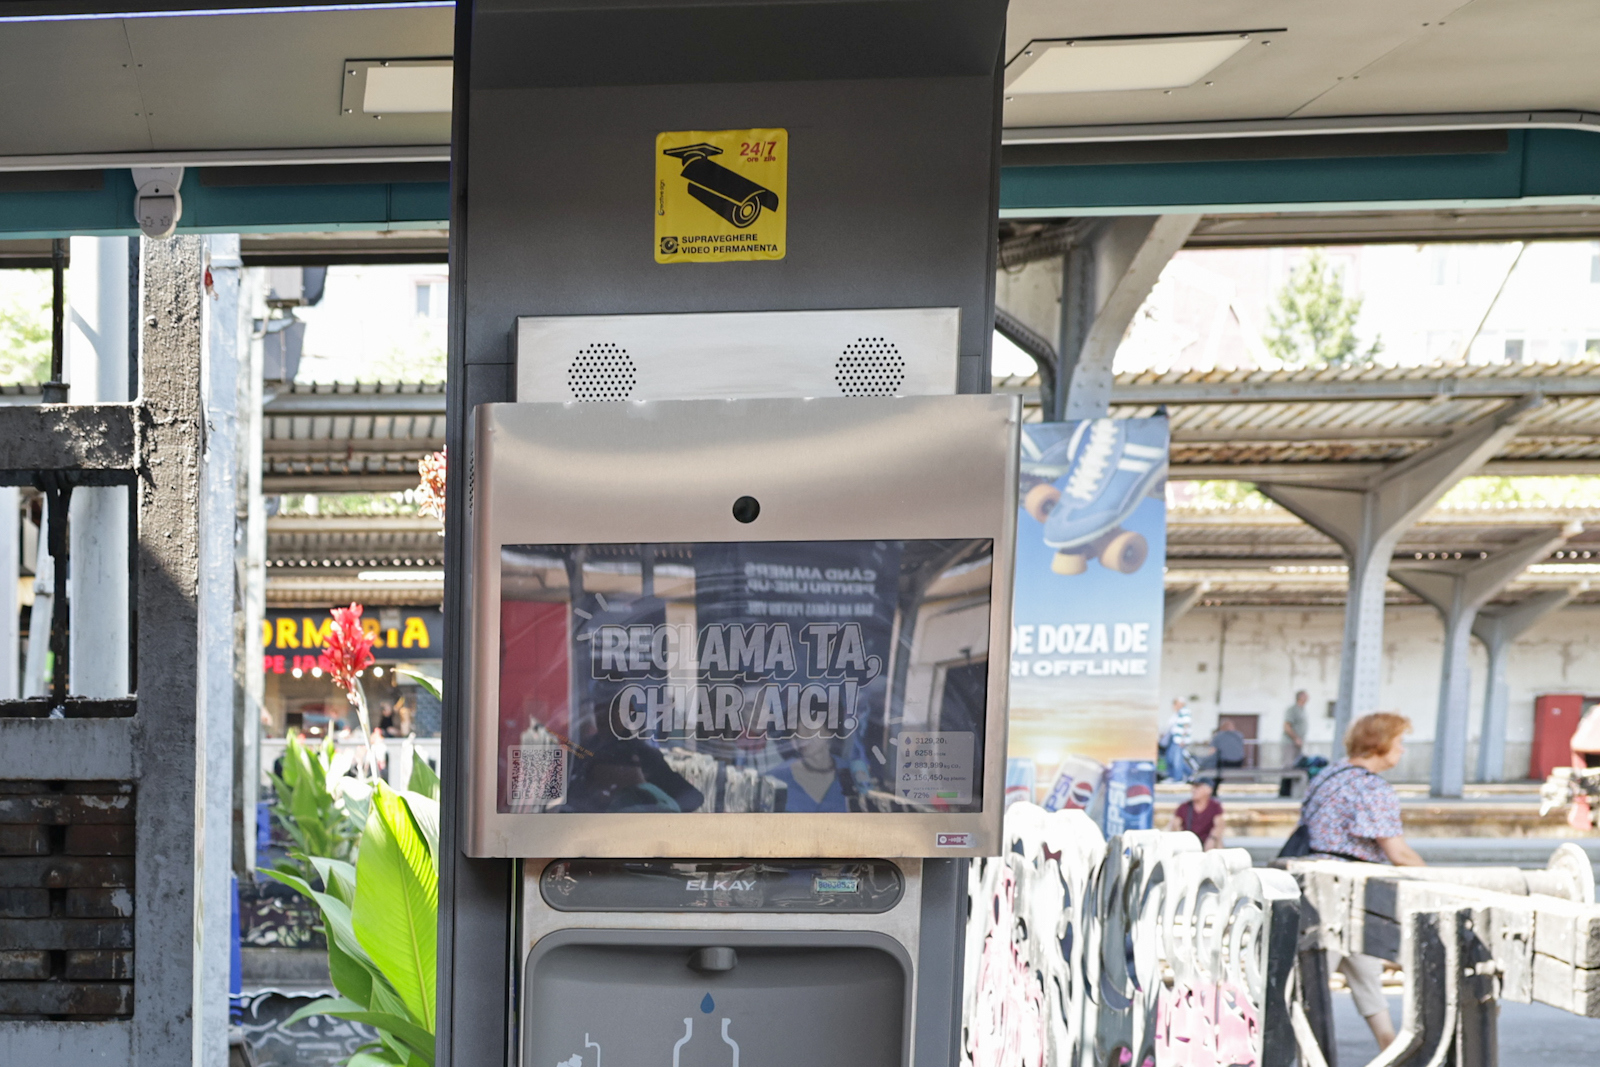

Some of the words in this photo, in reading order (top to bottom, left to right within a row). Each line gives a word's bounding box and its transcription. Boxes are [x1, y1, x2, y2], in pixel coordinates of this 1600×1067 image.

[740, 141, 777, 157] 24/7
[682, 233, 758, 243] SUPRAVEGHERE
[682, 246, 710, 254] VIDEO
[713, 244, 778, 253] PERMANENTA
[1038, 623, 1109, 655] DOZA
[1114, 622, 1150, 653] DE
[595, 624, 796, 678] RECLAMA
[803, 623, 882, 684] TA,
[1032, 659, 1148, 676] OFFLINE
[612, 683, 744, 737] CHIAR
[749, 680, 858, 737] AICI!
[685, 879, 757, 891] ELKAY
